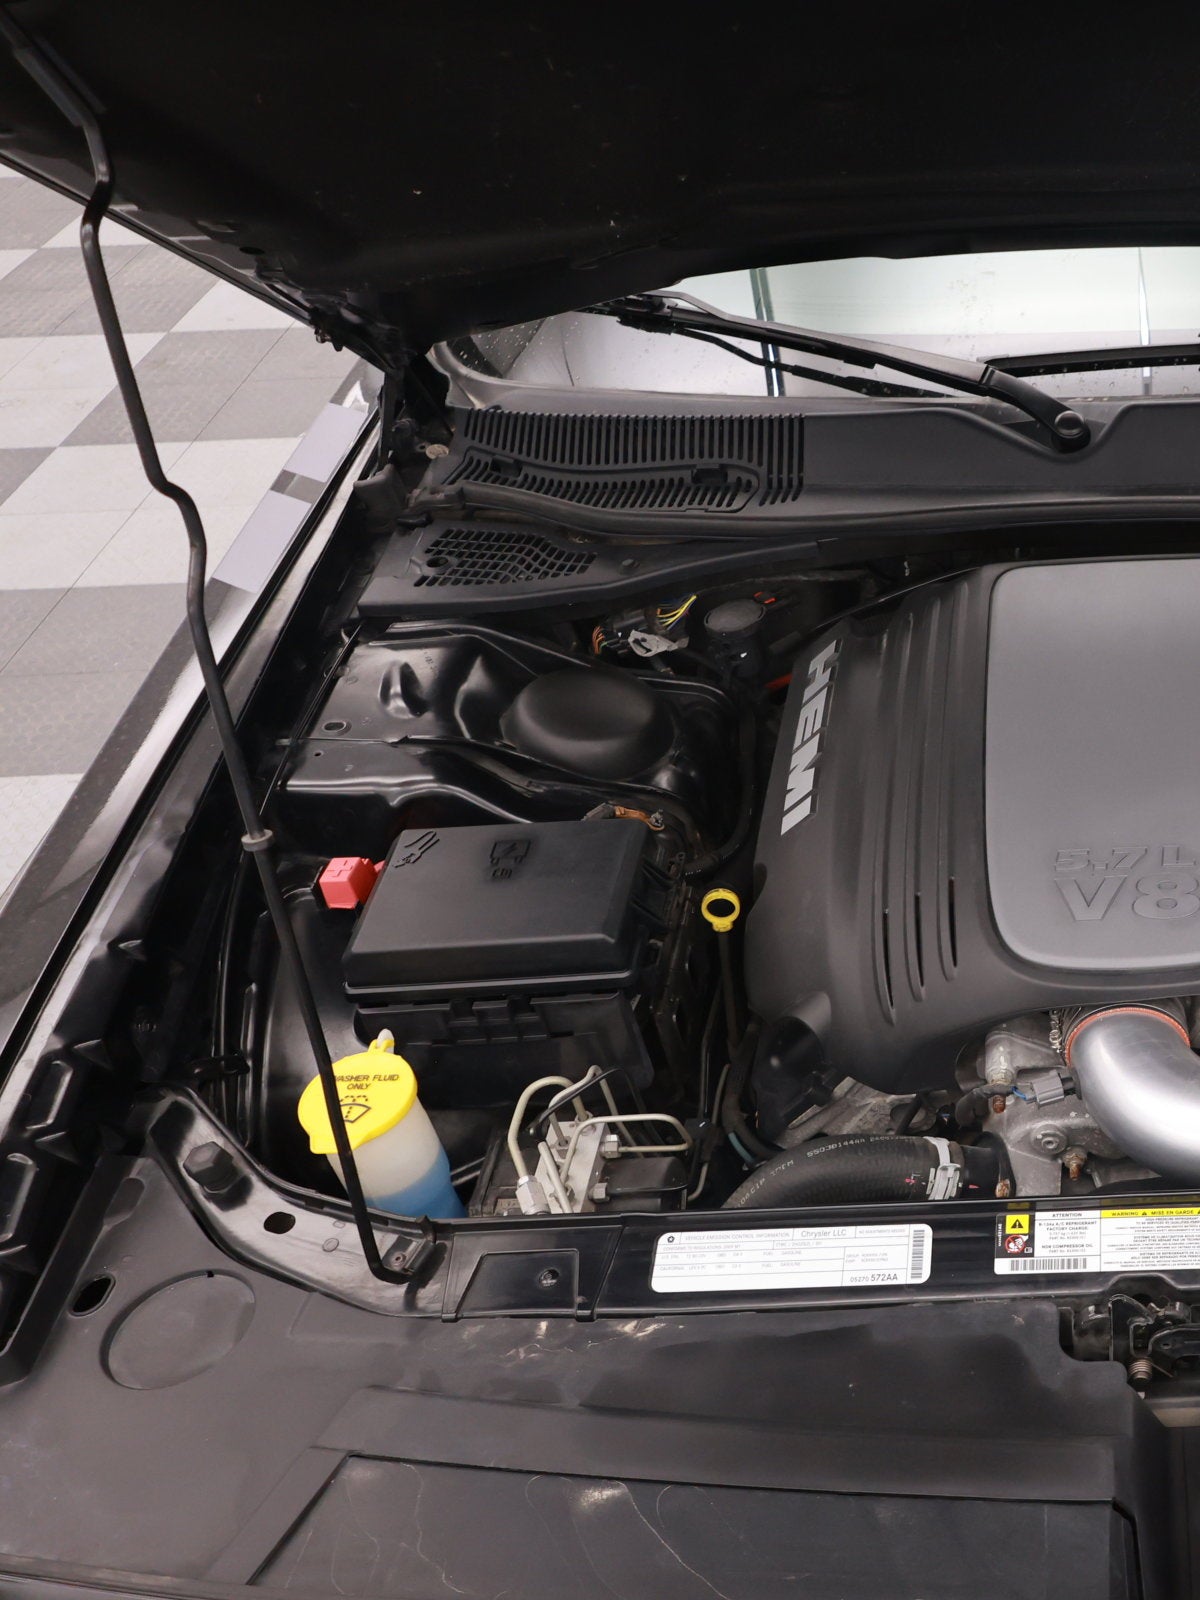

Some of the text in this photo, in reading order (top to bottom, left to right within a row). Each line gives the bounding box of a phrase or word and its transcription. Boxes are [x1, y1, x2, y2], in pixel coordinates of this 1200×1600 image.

[781, 639, 838, 836] HEMI
[1054, 844, 1197, 872] 5.7L
[372, 1073, 400, 1081] FLUID
[801, 1229, 847, 1239] Chrysler LLC
[870, 1273, 898, 1282] 572AA
